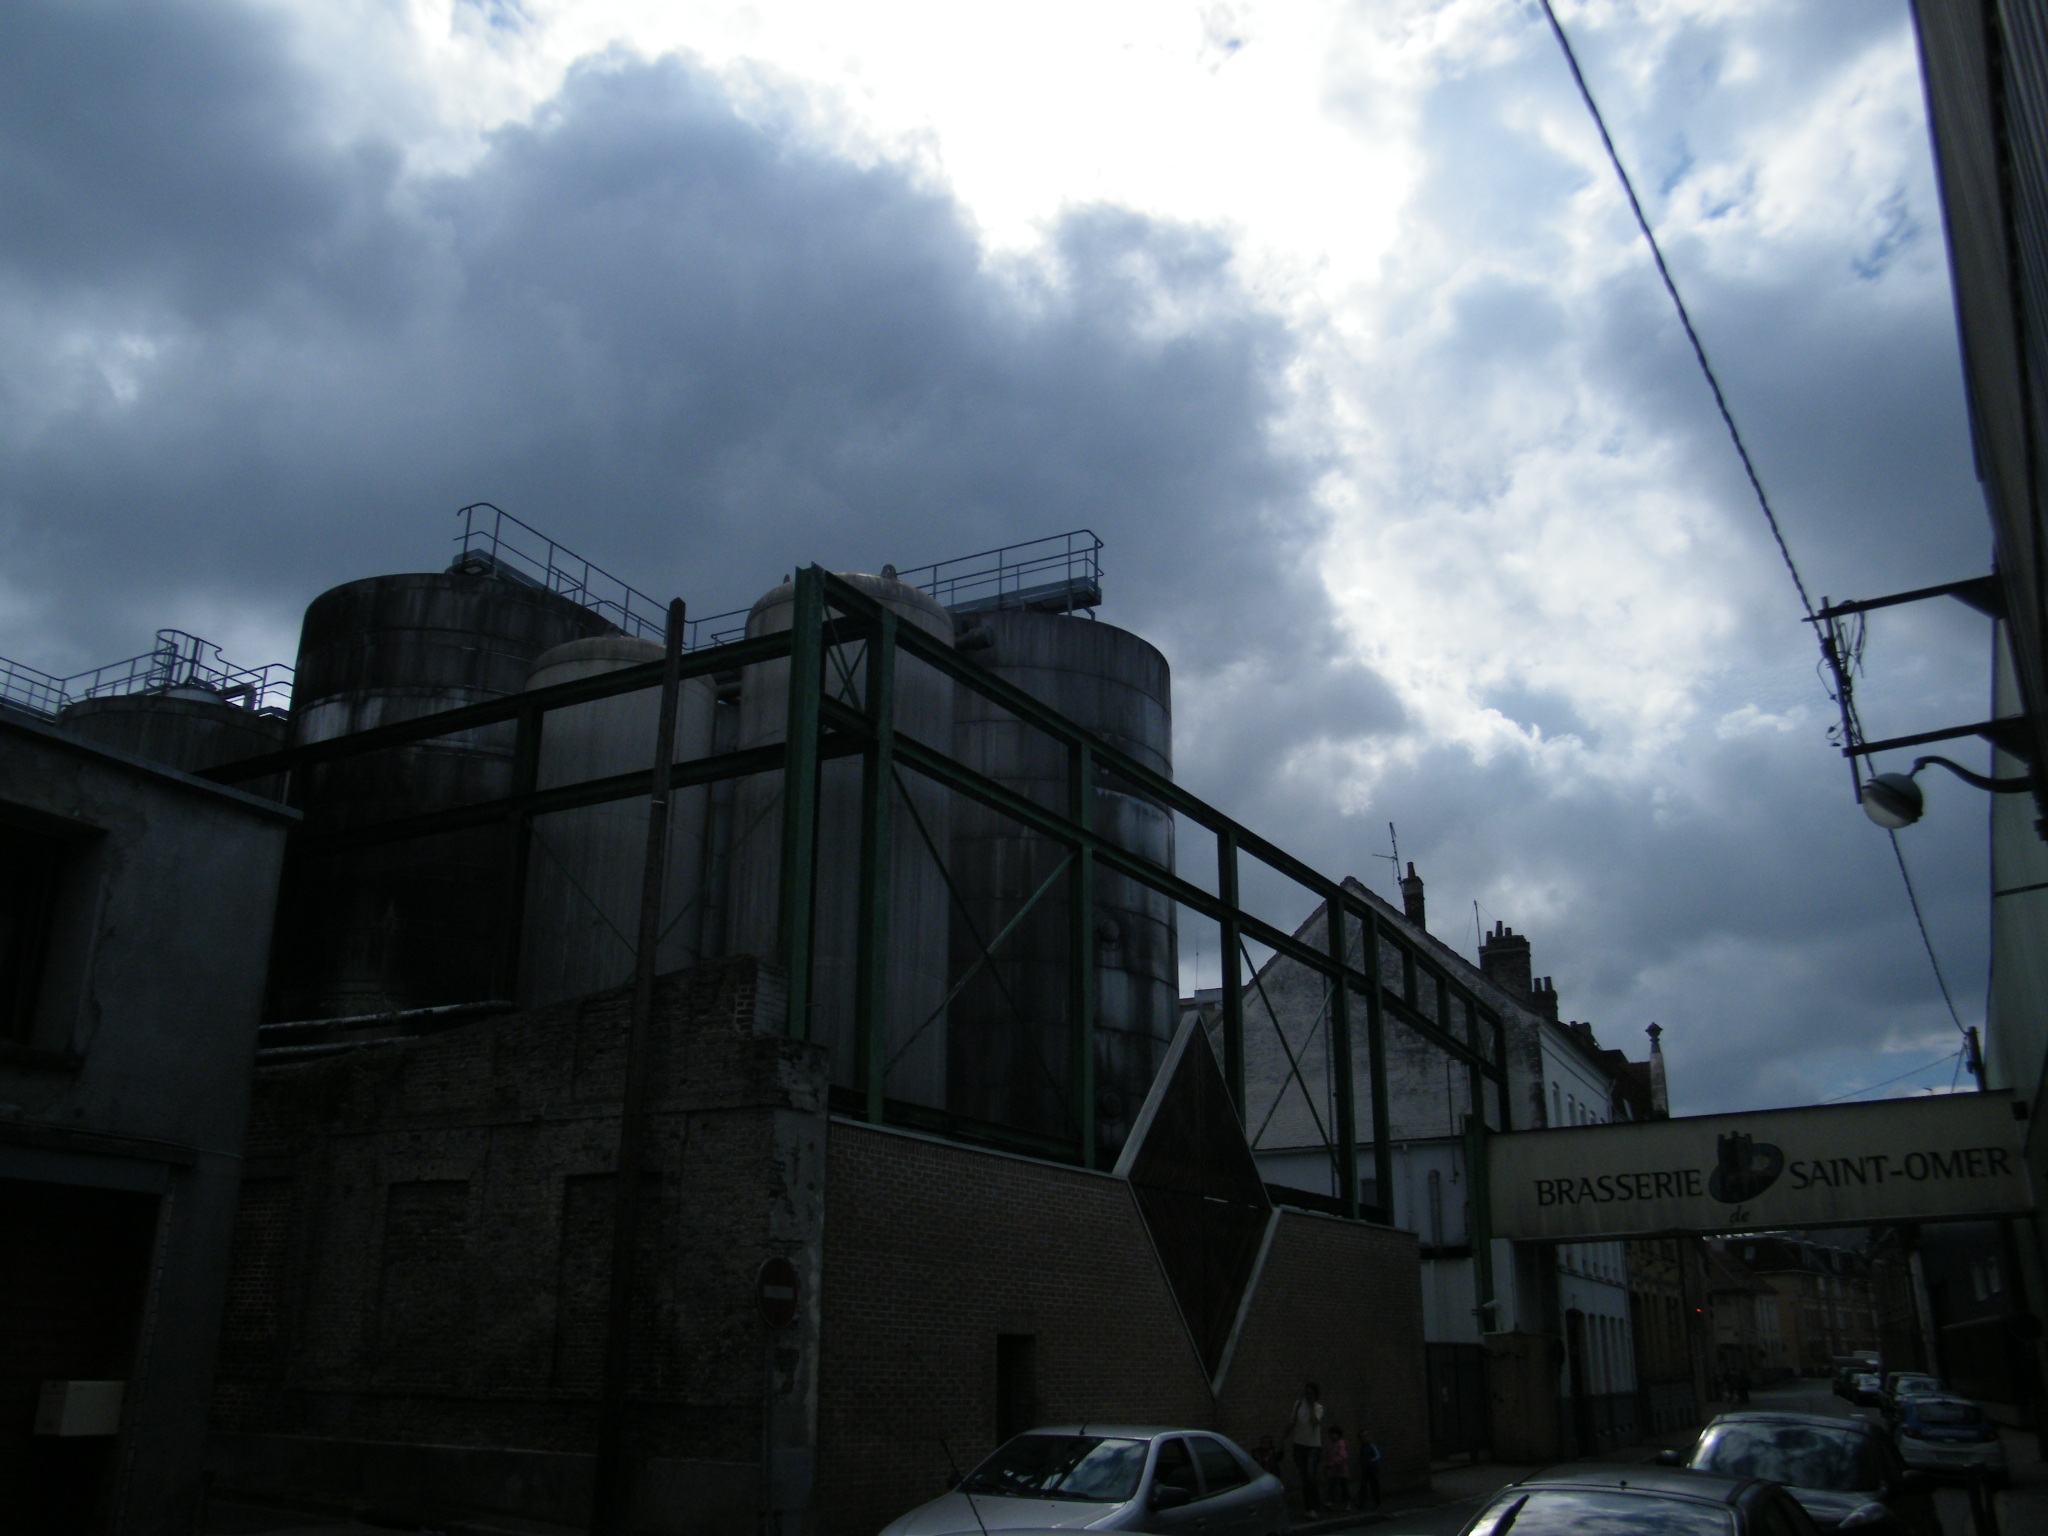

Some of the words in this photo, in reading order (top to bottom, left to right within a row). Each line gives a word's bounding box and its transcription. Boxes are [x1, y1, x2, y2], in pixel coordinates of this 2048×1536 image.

[1535, 1170, 1703, 1206] BRASSERIE
[1789, 1147, 2012, 1190] SAINT-OMER
[1729, 1205, 1750, 1223] de
